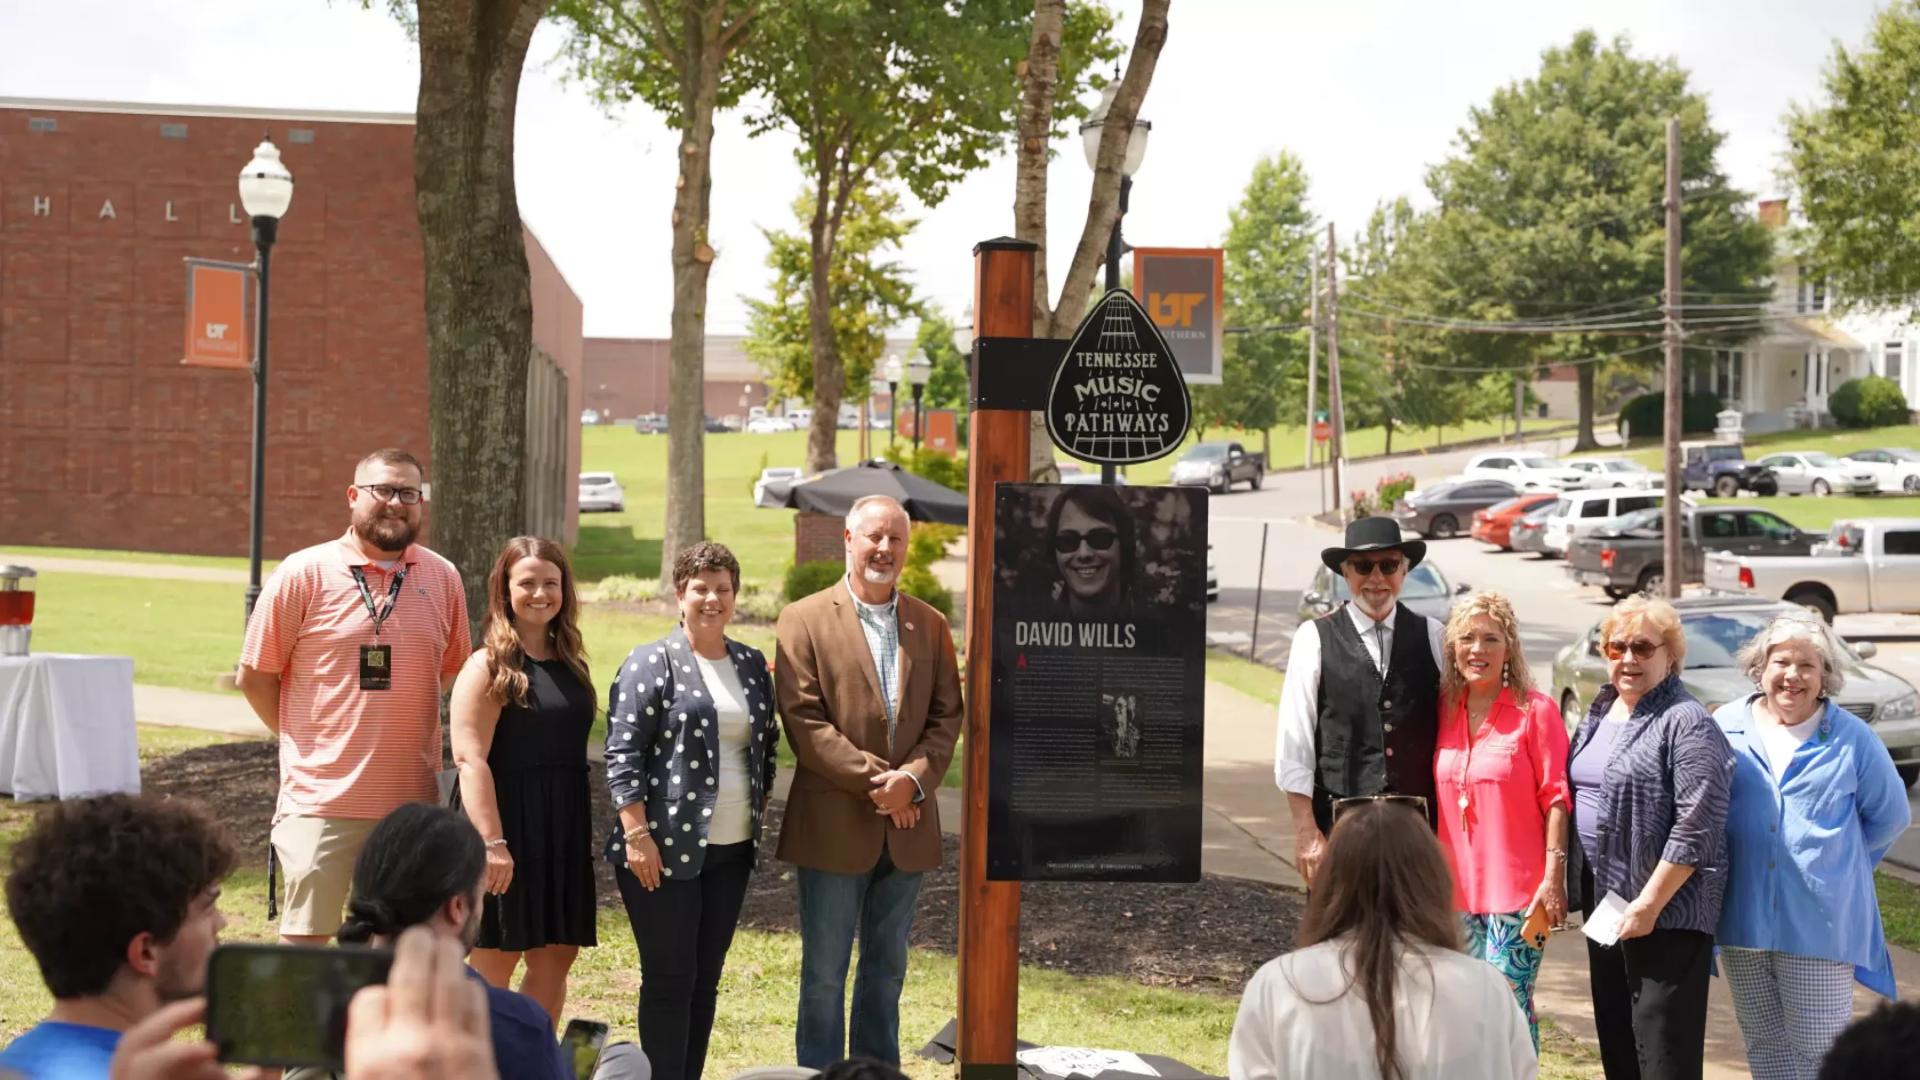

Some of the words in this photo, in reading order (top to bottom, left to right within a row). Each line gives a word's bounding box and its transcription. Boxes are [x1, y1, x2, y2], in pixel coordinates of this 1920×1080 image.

[33, 196, 242, 224] HALL
[1148, 292, 1206, 328] UT
[1160, 330, 1206, 339] UTHERN
[1076, 352, 1157, 368] TENNESSEE
[1073, 376, 1161, 402] MUSIC
[1064, 413, 1169, 432] PATHWAYS
[1015, 621, 1073, 646] DAVID
[1078, 622, 1136, 648] WILLS
